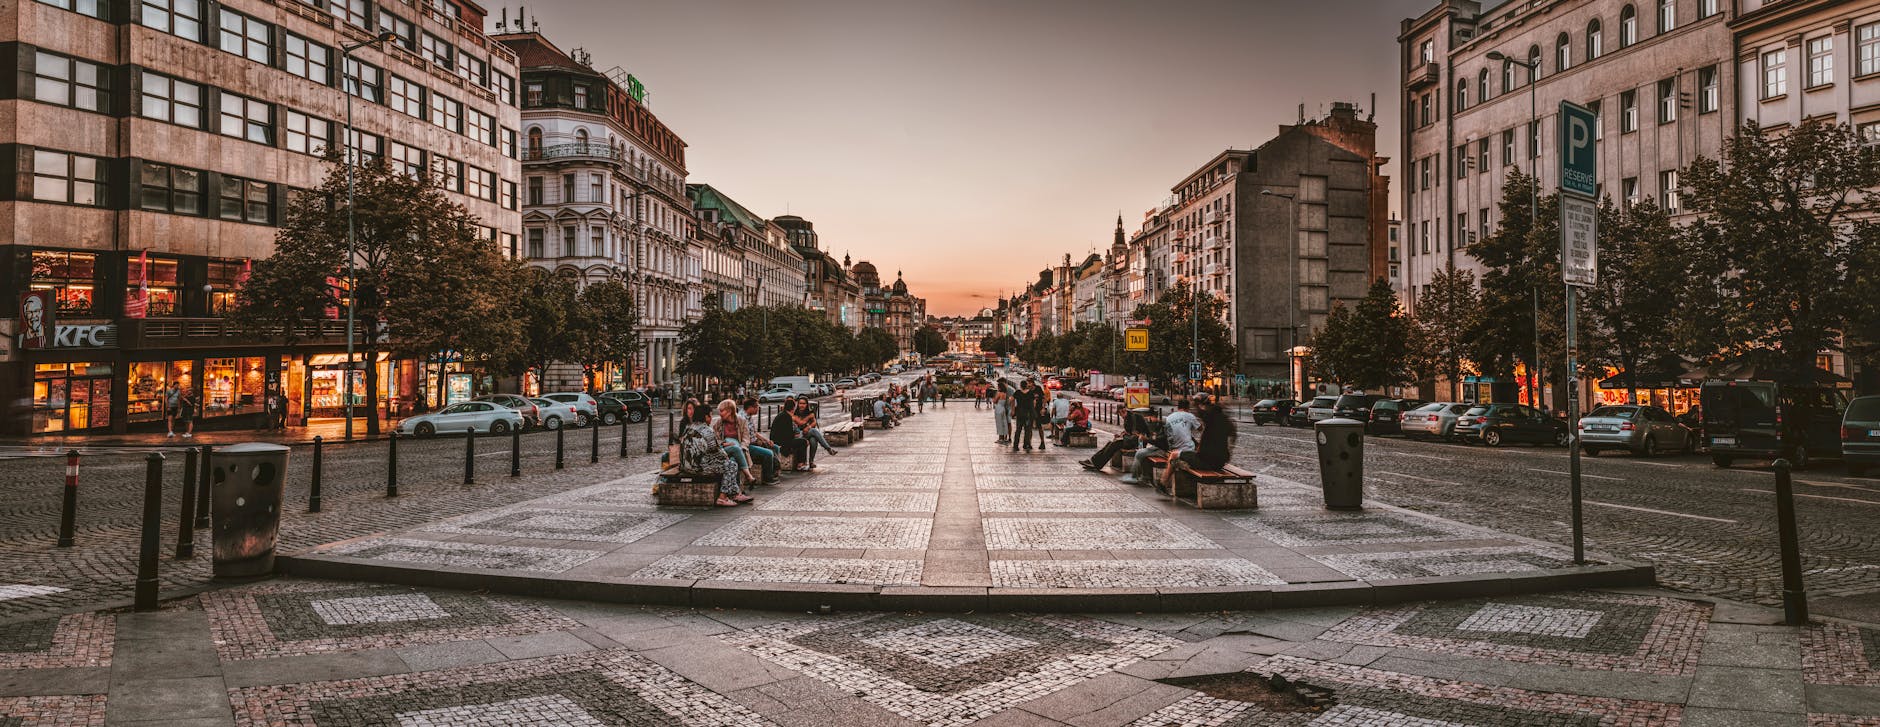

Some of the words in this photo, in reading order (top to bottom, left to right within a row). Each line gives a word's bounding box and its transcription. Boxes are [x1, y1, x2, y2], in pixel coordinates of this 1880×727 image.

[1569, 115, 1589, 165] P
[54, 325, 107, 347] KFC
[1130, 335, 1144, 344] TAXI
